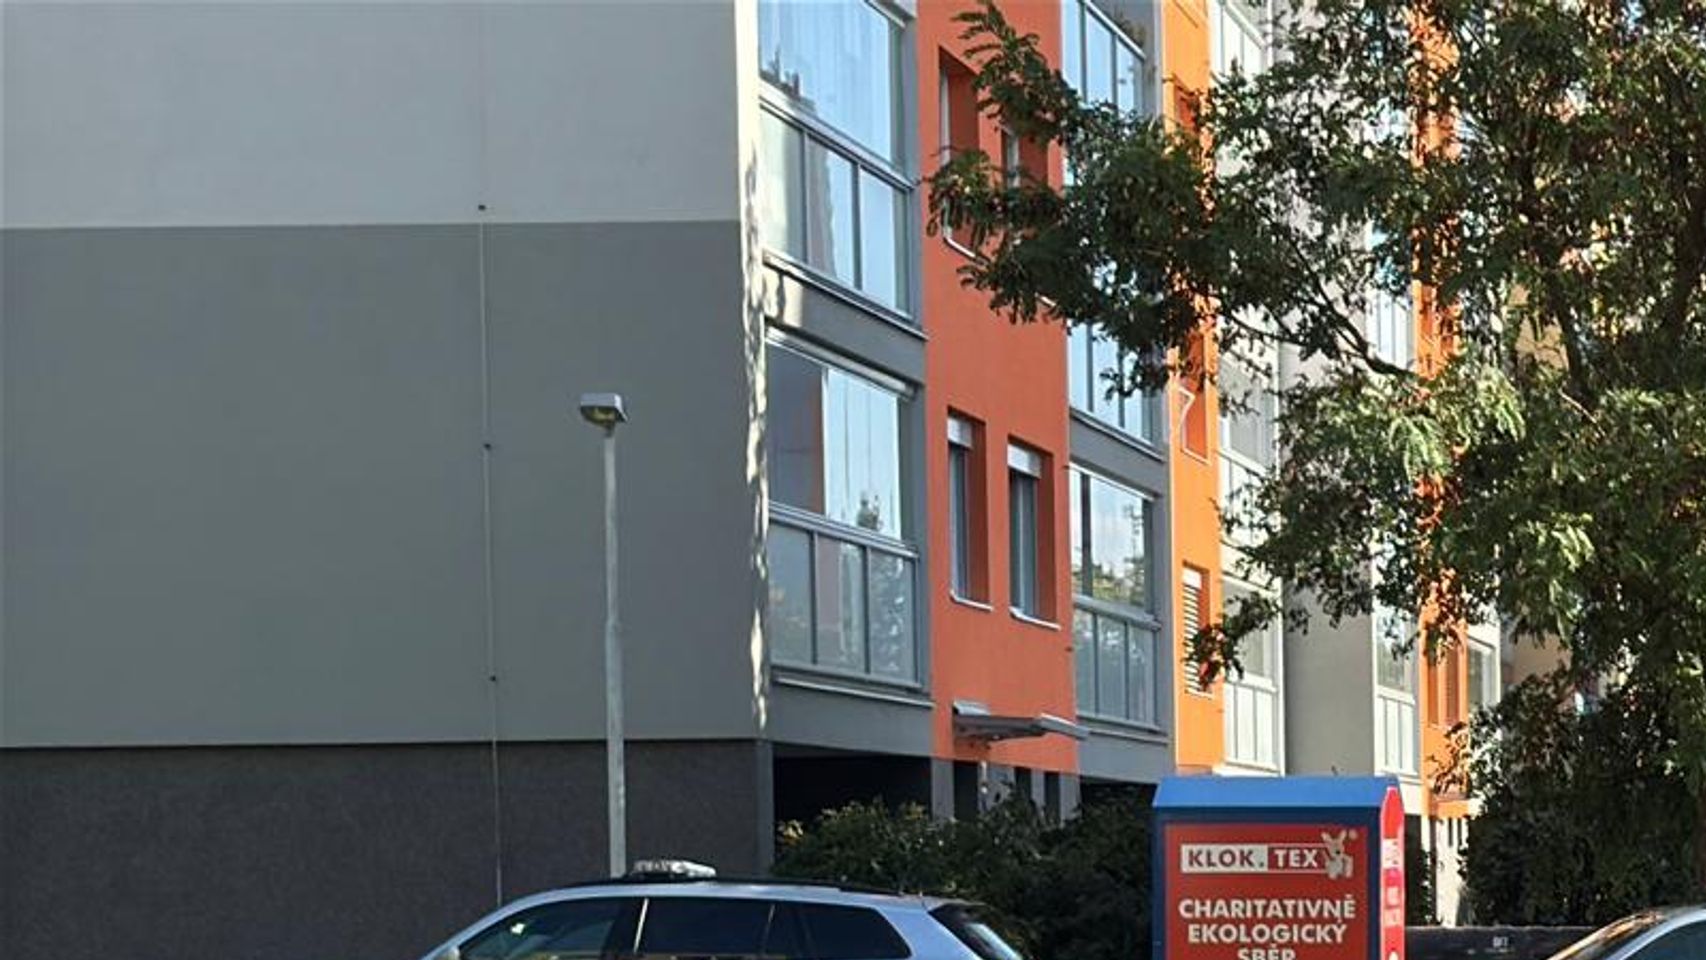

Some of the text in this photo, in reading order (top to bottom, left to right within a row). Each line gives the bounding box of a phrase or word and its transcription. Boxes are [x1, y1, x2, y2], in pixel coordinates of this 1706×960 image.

[1275, 849, 1318, 868] TEX
[1178, 894, 1356, 919] CHARITATIVNĚ
[1188, 919, 1347, 943] EKOLOGICKÝ
